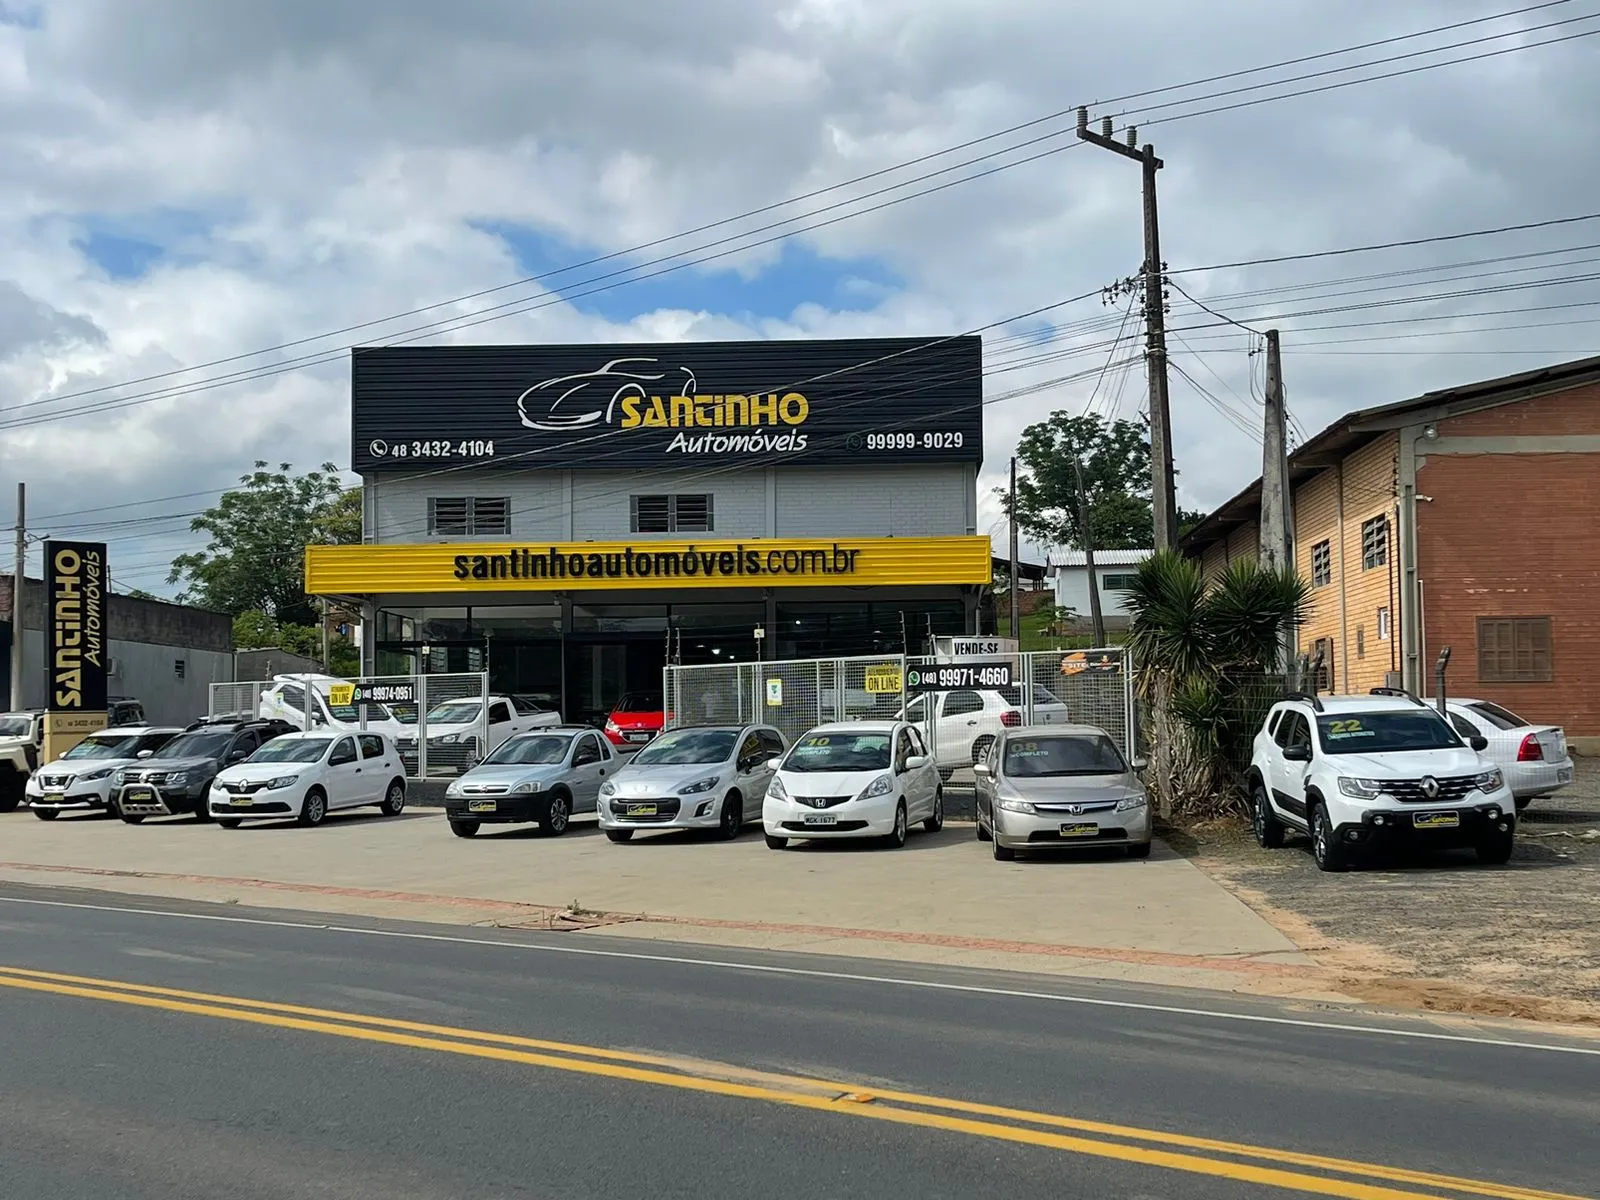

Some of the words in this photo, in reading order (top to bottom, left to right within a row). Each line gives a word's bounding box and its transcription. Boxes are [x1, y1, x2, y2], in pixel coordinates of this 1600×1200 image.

[391, 444, 407, 457] 48
[411, 440, 494, 457] 3432-4104
[666, 429, 808, 453] Automóveis
[867, 432, 963, 449] 99999-9029
[454, 543, 860, 579] santinhoautomóveis.com.br
[82, 550, 100, 667] Automóveis
[868, 678, 880, 690] ON
[881, 677, 899, 690] LINE
[922, 672, 937, 684] (48)
[939, 668, 1008, 686] 99971-4660
[372, 686, 412, 700] 99974-0951
[1329, 719, 1363, 733] 22
